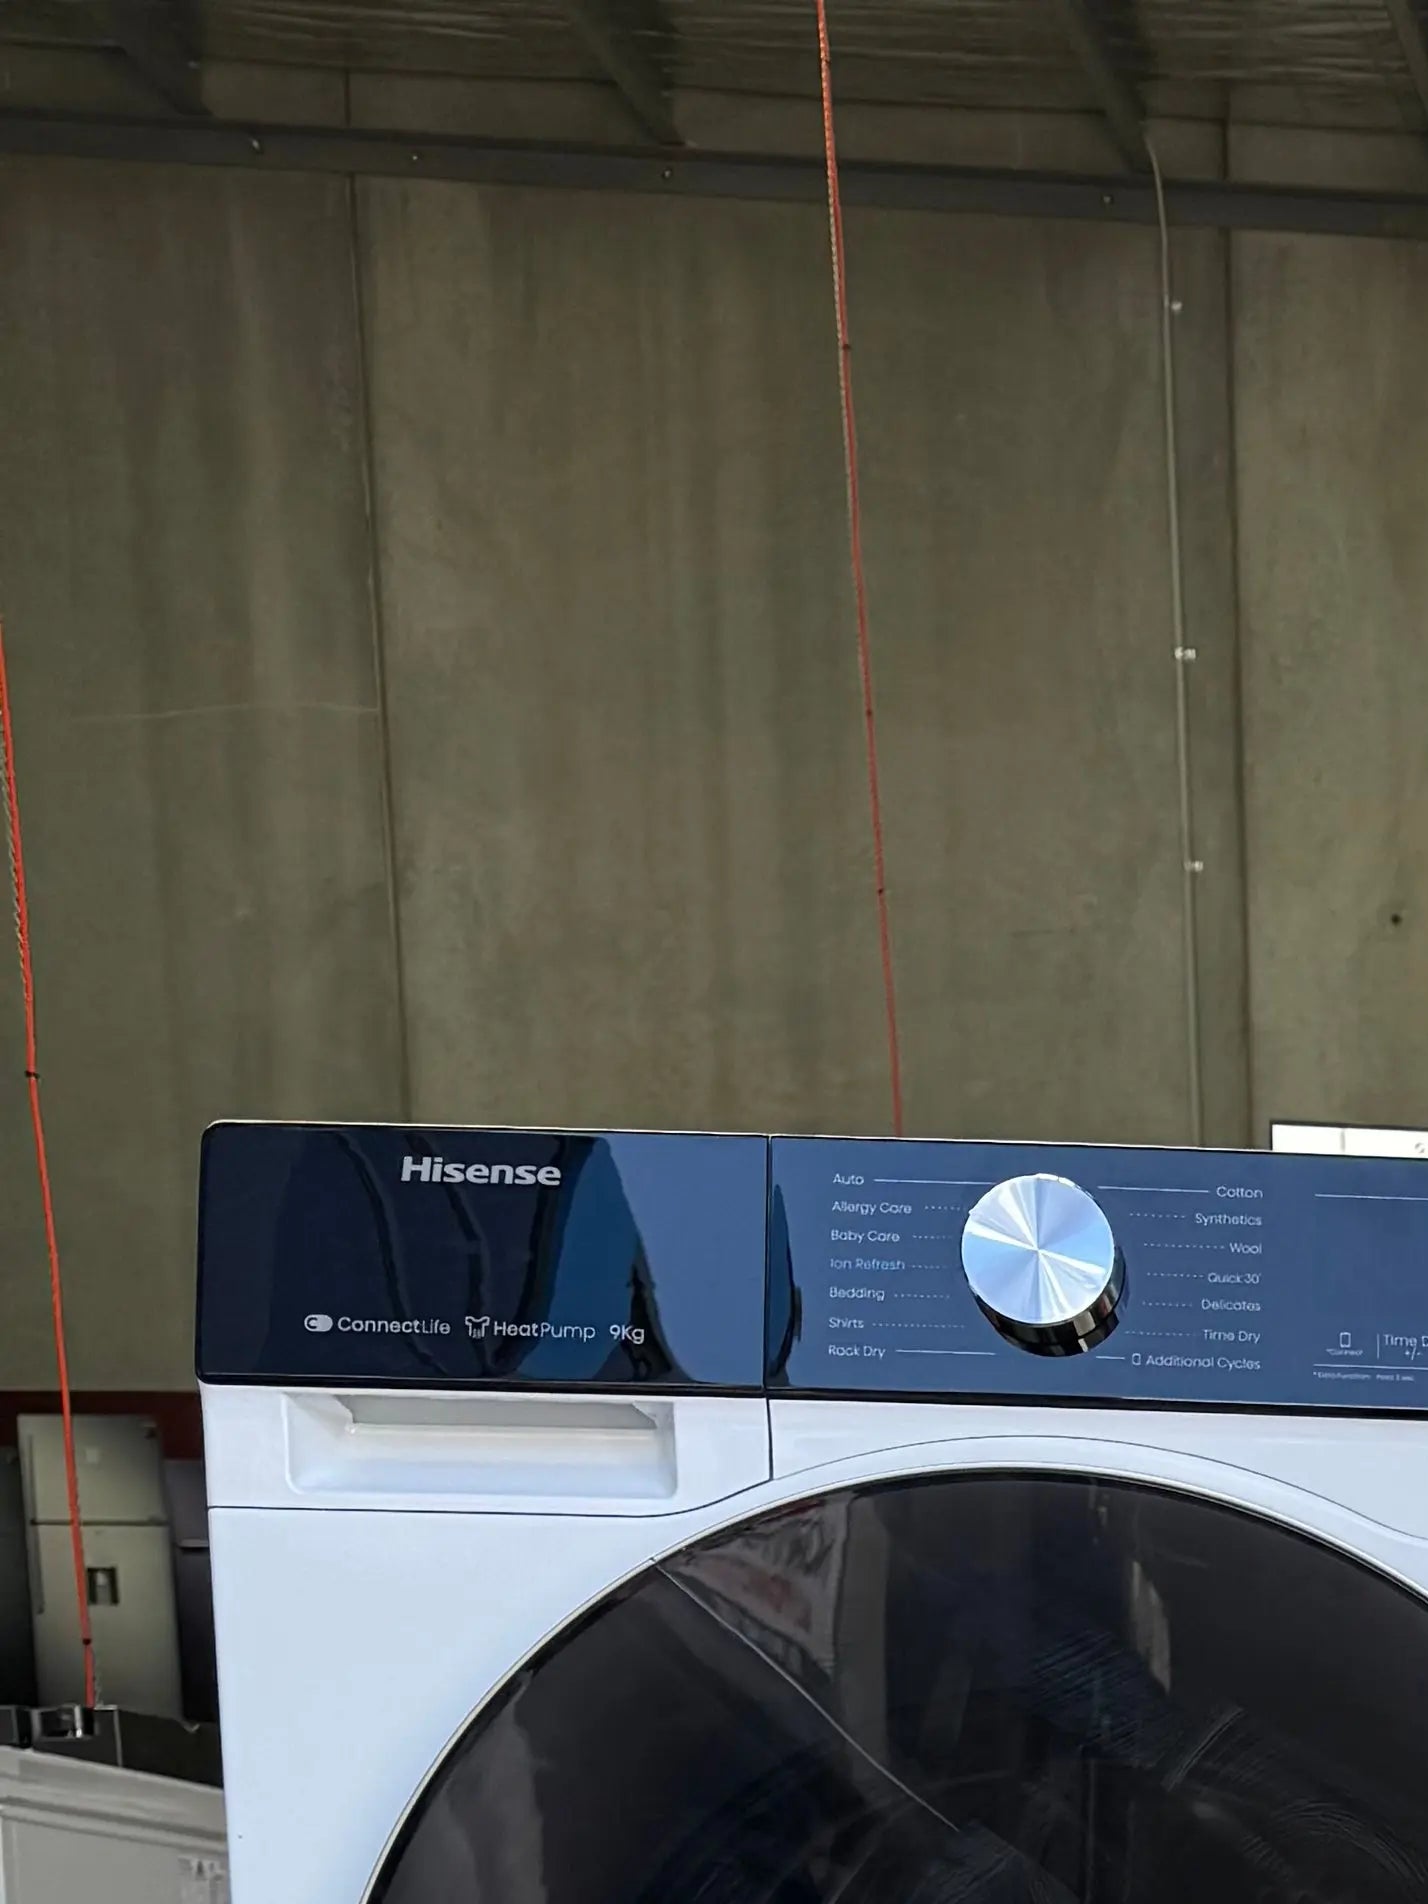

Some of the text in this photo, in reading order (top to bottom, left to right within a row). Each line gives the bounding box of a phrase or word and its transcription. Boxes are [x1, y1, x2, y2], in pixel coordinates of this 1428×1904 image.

[400, 1156, 562, 1187] Hisense
[833, 1173, 864, 1185] Auto
[1216, 1186, 1263, 1198] Cotton
[831, 1201, 912, 1215] Allergy Care
[1195, 1213, 1262, 1226] Synthetics
[831, 1229, 900, 1243] Baby Care
[1229, 1243, 1262, 1254] Wool
[830, 1259, 905, 1270] Ion Refresh
[829, 1287, 885, 1301] Bedding
[1201, 1299, 1261, 1311] Delicates
[829, 1317, 864, 1328] Shirts
[338, 1317, 451, 1335] ConnectLife
[609, 1324, 645, 1345] 9Kg
[1204, 1329, 1261, 1344] Time Dry
[1384, 1334, 1417, 1347] Time
[829, 1345, 886, 1359] Rack Dry
[1146, 1355, 1261, 1371] Additional Cycles
